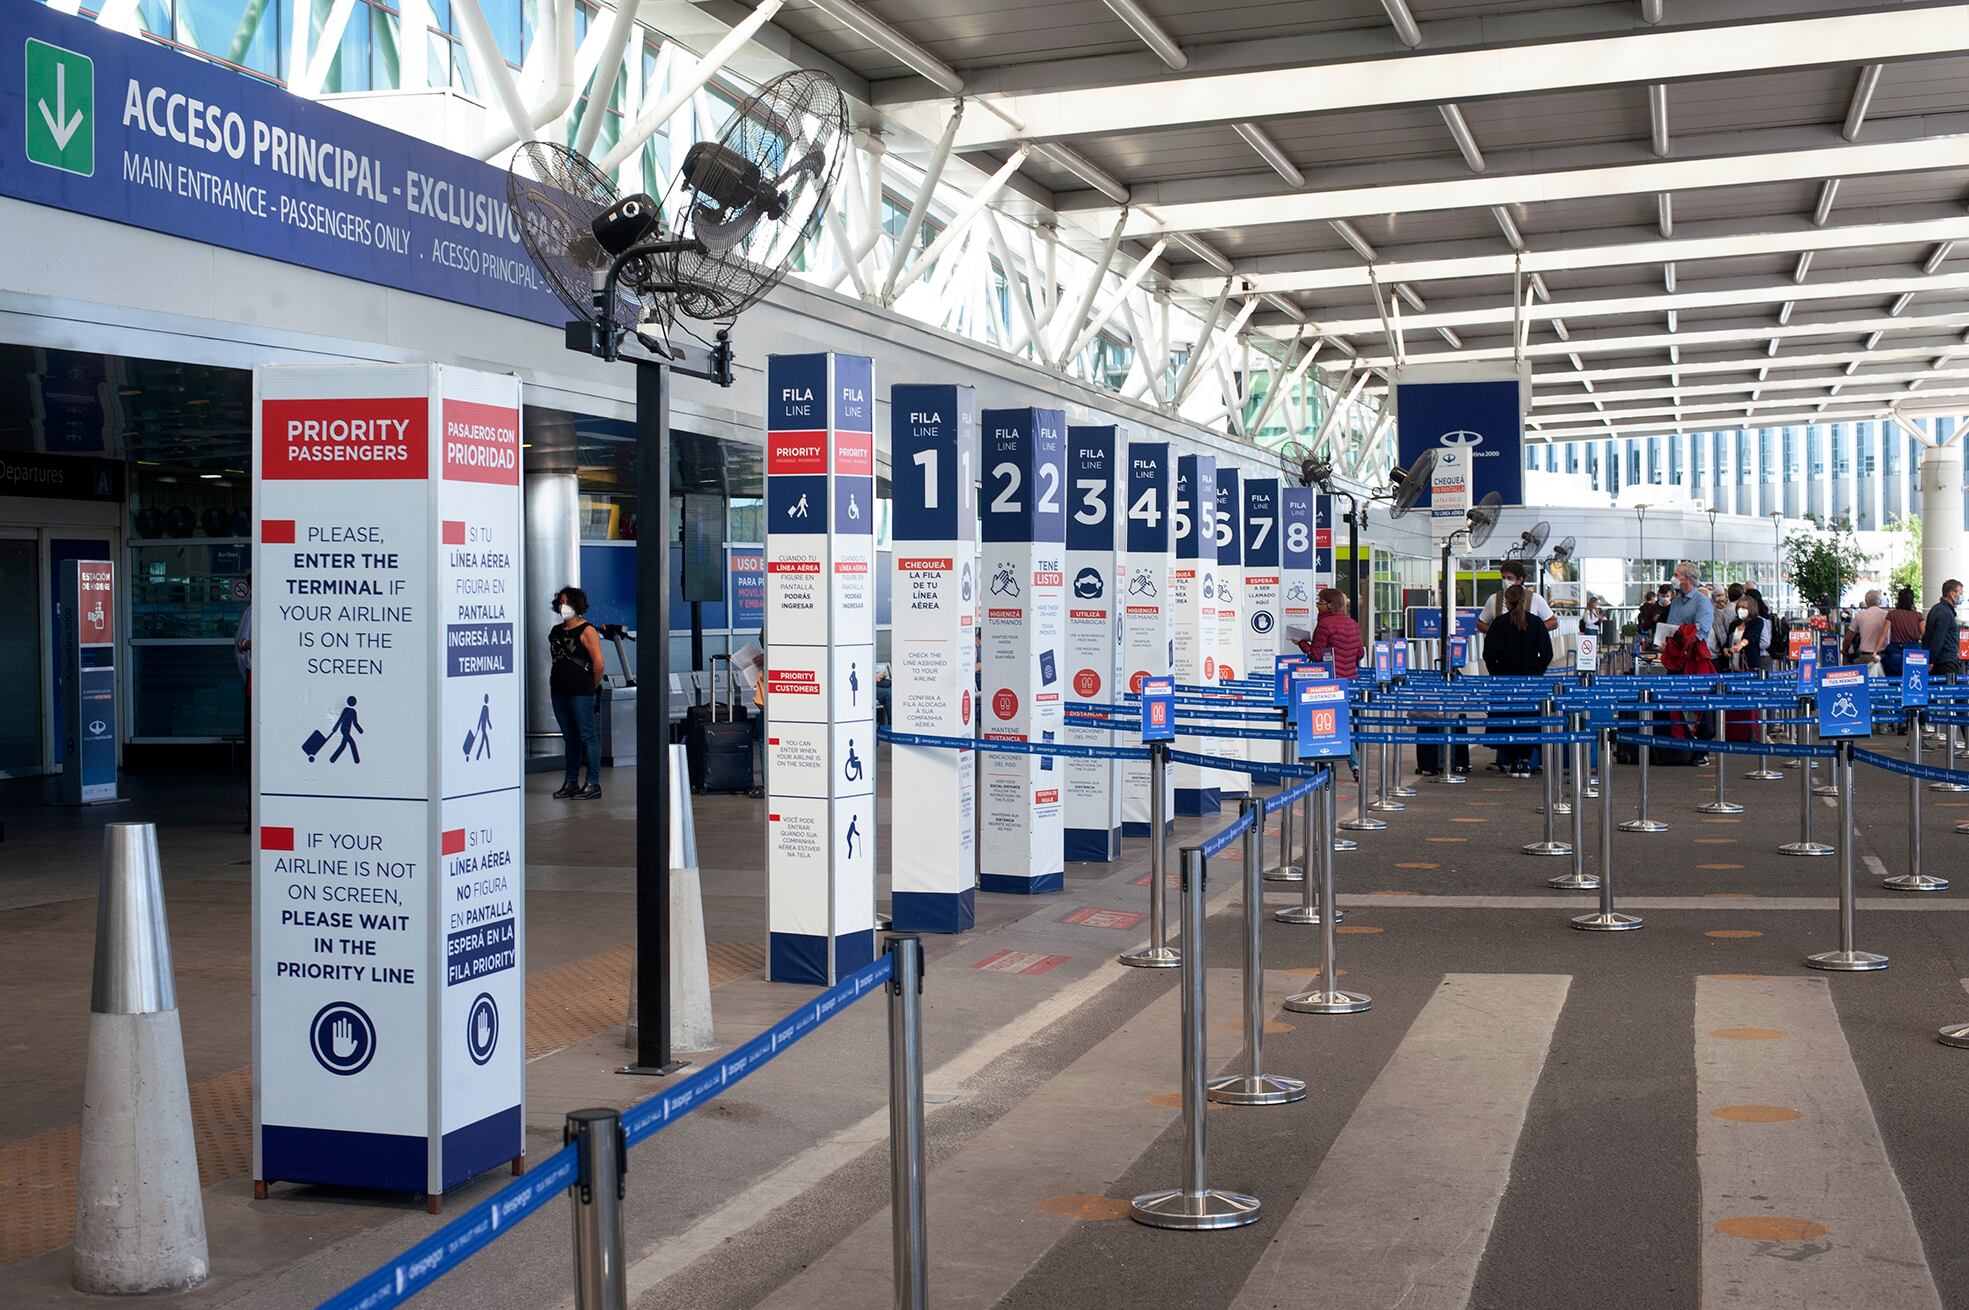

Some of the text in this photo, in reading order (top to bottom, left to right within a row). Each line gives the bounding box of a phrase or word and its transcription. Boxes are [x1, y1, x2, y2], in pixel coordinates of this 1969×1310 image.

[122, 78, 246, 160] ACCESO
[253, 126, 388, 205] PRINCIPAL
[407, 172, 522, 244] EXCLUSIVO
[123, 151, 173, 193] MAIN
[178, 170, 267, 219] ENTRANCE
[280, 195, 371, 247] PASSENGERS
[375, 227, 411, 257] ONLY
[432, 241, 480, 274] ACESSO
[483, 253, 537, 290] PRINCIPAL
[783, 388, 814, 401] FILA
[843, 388, 863, 402] FILA
[785, 405, 811, 417] LINE
[844, 406, 862, 417] LINE
[910, 412, 941, 424] FILA
[287, 419, 409, 441] PRIORITY
[447, 421, 515, 444] PASAJEROS CON
[913, 427, 939, 437] LINE
[995, 428, 1019, 439] FILA
[1041, 428, 1057, 440] FILA
[288, 445, 408, 462] PASSENGERS
[776, 447, 821, 457] PRIORITY
[838, 448, 868, 458] PRIORITY
[997, 442, 1017, 451] LINE
[1042, 442, 1056, 451] LINE
[1079, 449, 1104, 458] FILA
[447, 442, 515, 470] PRIORIDAD
[1134, 460, 1157, 469] FILA
[1082, 461, 1102, 469] LINE
[912, 449, 938, 509] 1
[1136, 471, 1155, 479] LINE
[1434, 475, 1465, 485] CHEQUEÁ
[991, 462, 1022, 513] 2
[1038, 462, 1059, 513] 2
[1073, 479, 1107, 525] 3
[1251, 494, 1270, 502] FILA
[1128, 487, 1161, 527] 4
[1175, 501, 1191, 539] 5
[1202, 501, 1215, 539] 5
[308, 527, 384, 545] PLEASE,
[470, 527, 492, 543] SI TU
[1216, 511, 1233, 548] 6
[1250, 517, 1273, 550] 7
[1286, 522, 1309, 553] 8
[294, 553, 398, 569] ENTER THE
[450, 547, 510, 569] LÍNEA AÉREA
[737, 559, 757, 570] USO
[904, 561, 946, 569] CHEQUEÁ
[286, 579, 406, 596] TERMINAL IF
[456, 579, 505, 594] FIGURA EN
[738, 578, 757, 586] PARA
[1037, 573, 1059, 585] LISTO
[913, 591, 938, 599] LÍNEA
[279, 605, 412, 622] YOUR AIRLINE
[458, 604, 506, 620] PANTALLA
[911, 601, 940, 609] AÉREA
[299, 632, 393, 649] IS ON THE
[448, 626, 513, 648] INGRESÁ A LA
[307, 658, 383, 676] SCREEN
[458, 656, 506, 673] TERMINAL
[780, 672, 814, 680] PRIORITY
[775, 685, 819, 693] CUSTOMERS
[307, 833, 383, 852] IF YOUR
[469, 829, 493, 848] SI TU
[274, 857, 416, 879] AIRLINE IS NOT
[450, 850, 512, 877] LÍNEA AÉREA
[288, 884, 403, 907] ON SCREEN,
[456, 879, 508, 902] NO FIGURA
[281, 911, 410, 932] PLEASE WAIT
[450, 899, 514, 929] EN PANTALLA
[314, 938, 376, 956] IN THE
[448, 928, 514, 956] ESPERÁ EN LA
[277, 962, 415, 984] PRIORITY LINE
[449, 949, 515, 984] FILA PRIORITY
